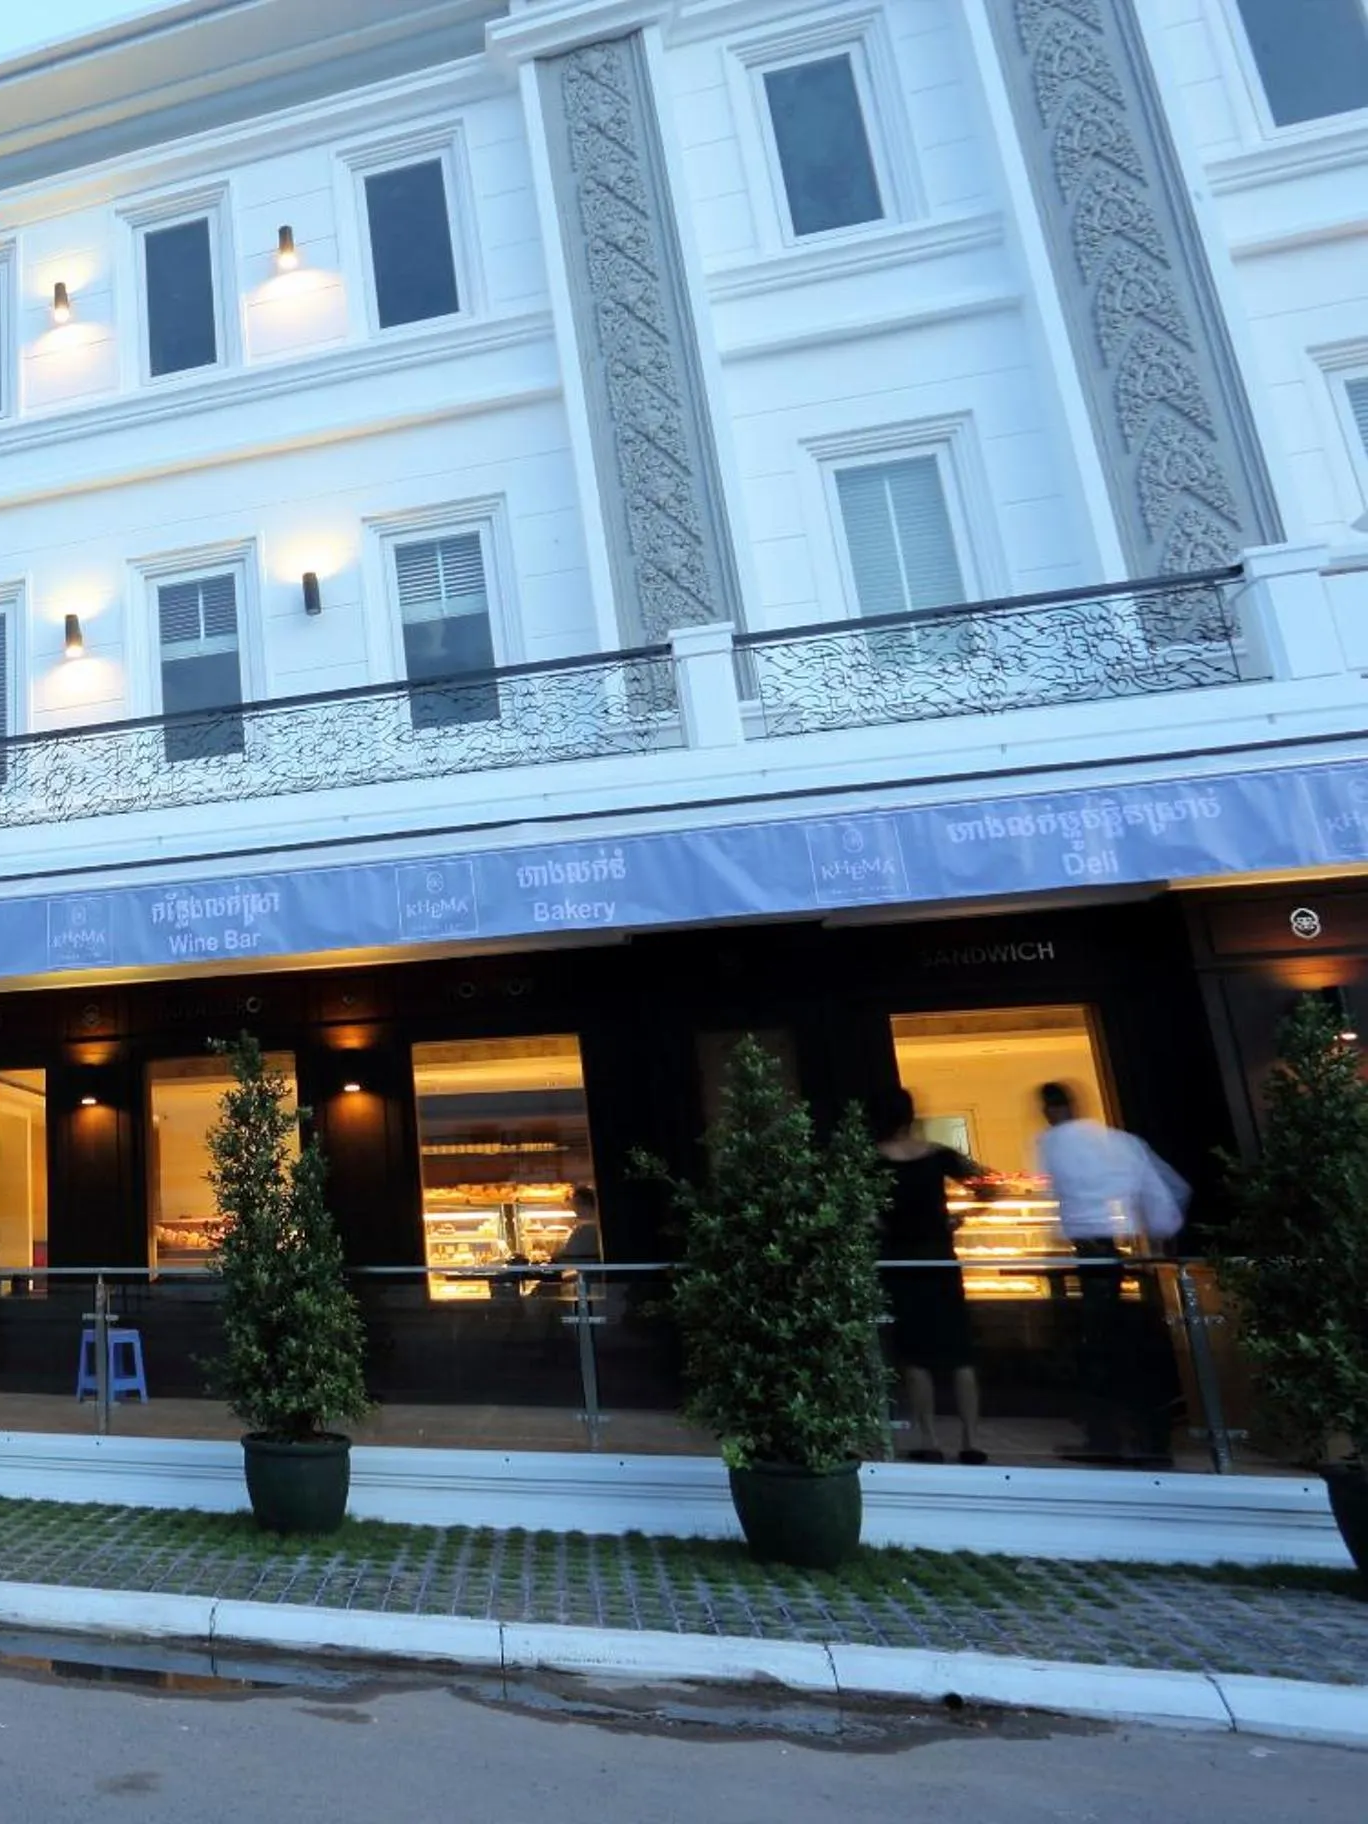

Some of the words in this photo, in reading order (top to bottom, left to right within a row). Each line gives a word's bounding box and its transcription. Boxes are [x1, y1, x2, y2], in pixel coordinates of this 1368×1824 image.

[1062, 850, 1119, 876] Deli
[533, 897, 616, 923] Bakery
[168, 932, 220, 957] Wine
[224, 928, 262, 951] Bar
